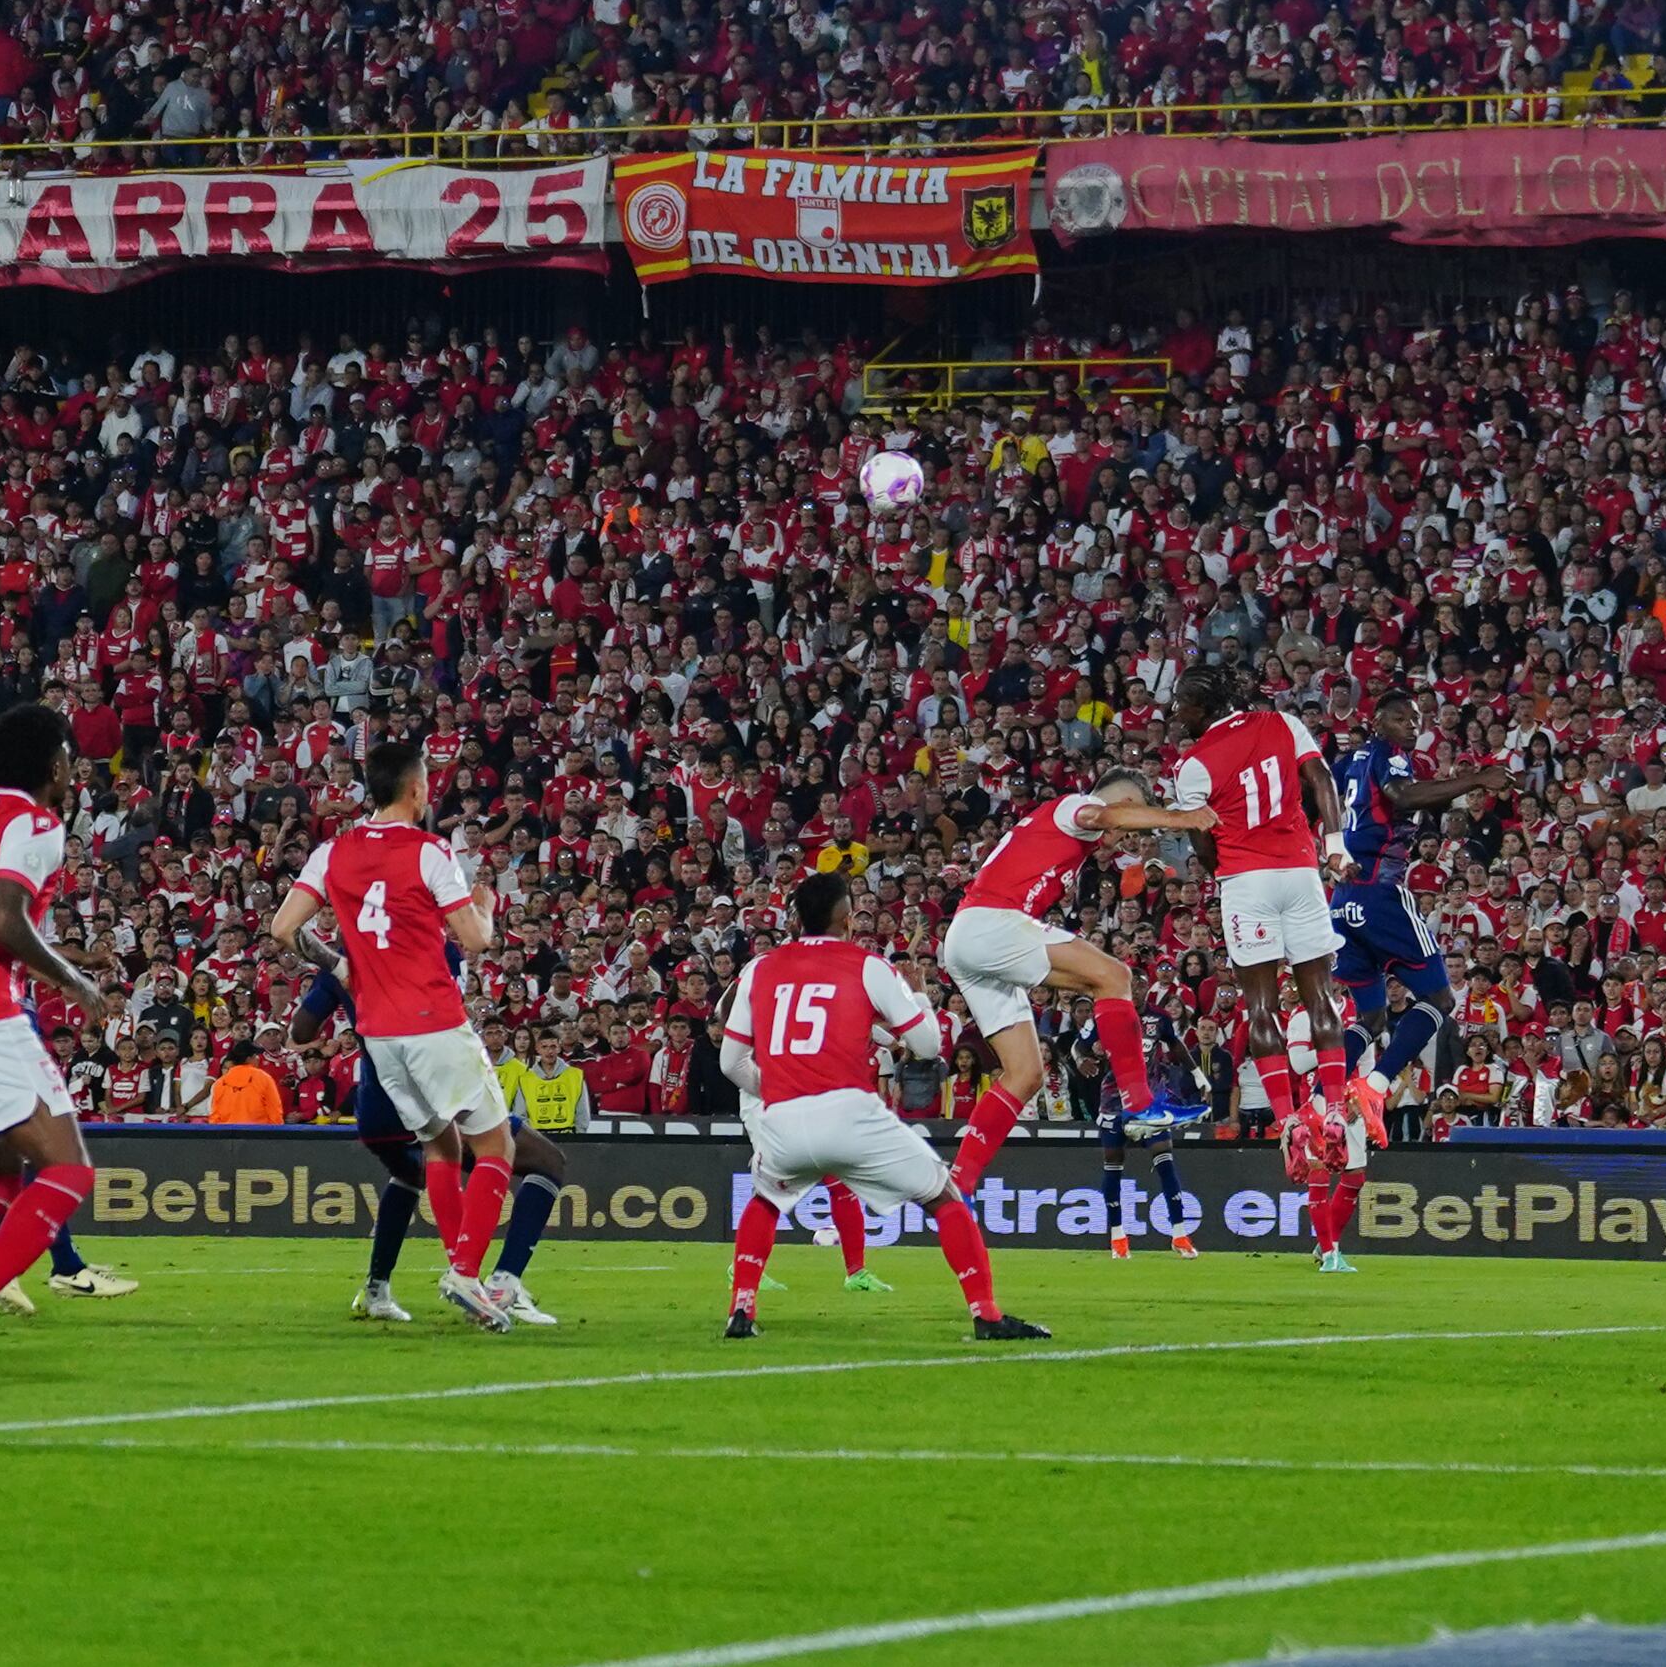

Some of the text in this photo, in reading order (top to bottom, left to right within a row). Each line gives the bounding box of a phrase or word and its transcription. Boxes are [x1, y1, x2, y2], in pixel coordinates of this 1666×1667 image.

[692, 151, 950, 204] LA FAMILIA
[798, 198, 837, 210] SANTA FE
[1132, 163, 1343, 225] CAPITAL
[1377, 157, 1483, 220] DEL
[440, 169, 587, 257] 25
[688, 230, 959, 277] DE ORIENTAL
[1238, 755, 1281, 829] 11
[357, 880, 391, 949] 4
[769, 983, 837, 1056] 15
[737, 1254, 763, 1268] FILA
